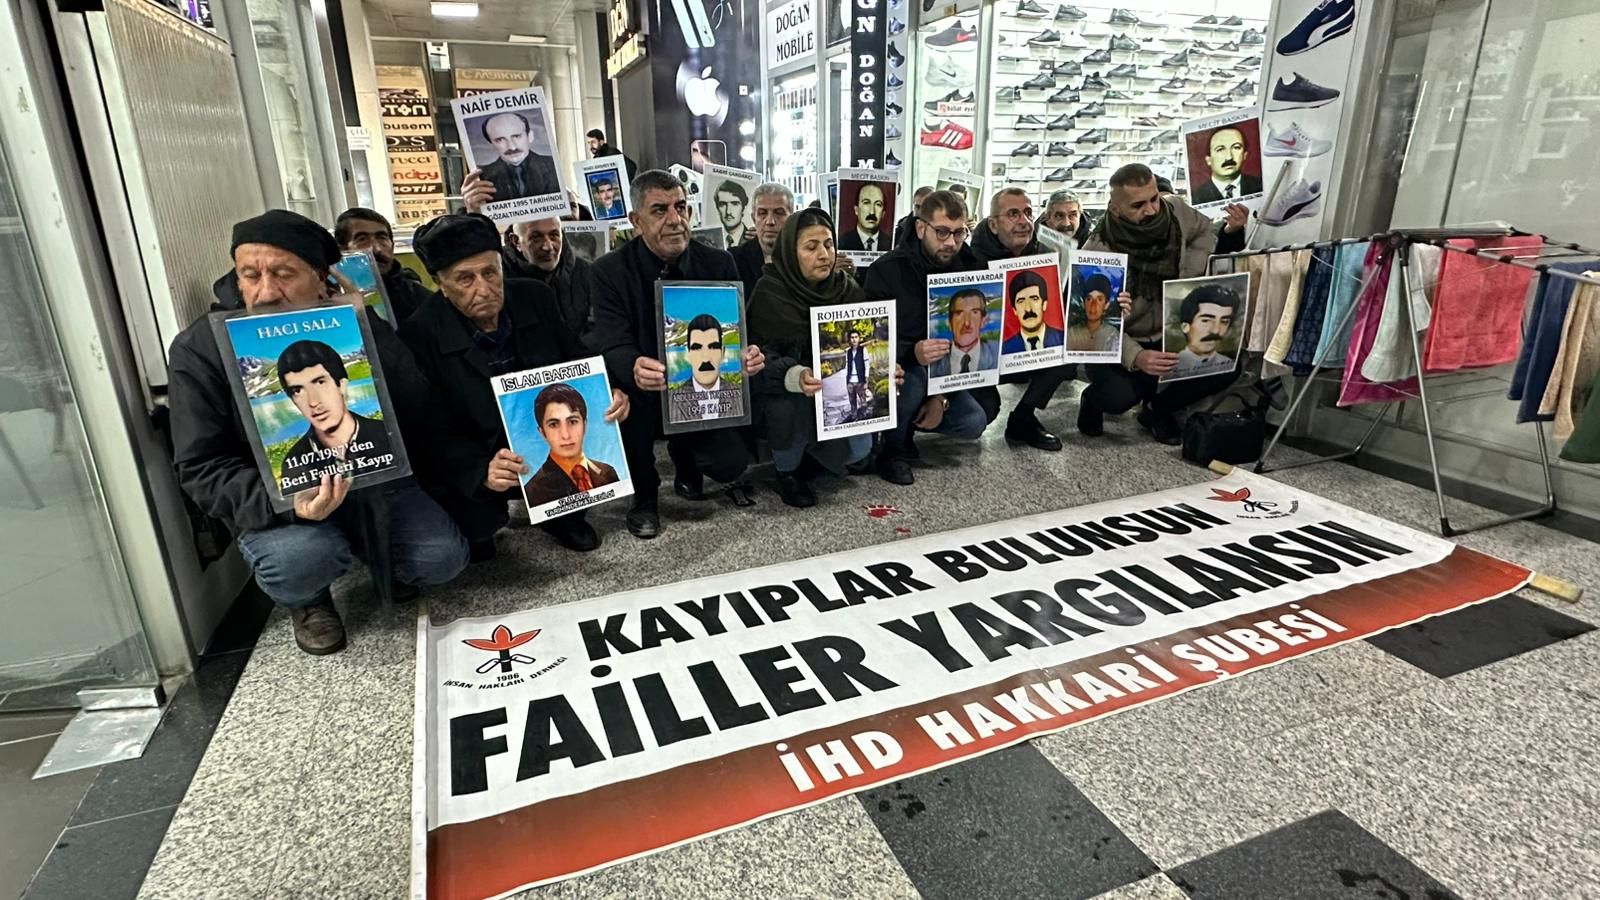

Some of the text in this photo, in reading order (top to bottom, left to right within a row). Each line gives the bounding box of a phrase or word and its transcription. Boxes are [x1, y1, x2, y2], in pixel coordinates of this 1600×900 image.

[776, 4, 810, 33] DOĞAN
[777, 30, 813, 62] MOBİLE
[460, 98, 492, 115] NAİF
[495, 91, 539, 109] DEMİR
[859, 54, 875, 137] DOĞAN
[489, 210, 530, 221] GÖZALTINDA
[492, 202, 512, 211] MART
[928, 273, 1004, 286] ABDULKERİM VARDAR
[257, 317, 341, 339] HACI SALA
[817, 306, 889, 321] ROJHAT ÖZDEL
[500, 362, 590, 392] İSLAM BARTIN
[286, 440, 374, 469] 11.07.1987'den
[281, 453, 393, 489] Beri Failleri Kayıp
[578, 503, 1231, 662] KAYIPLAR BULUNSUN
[450, 520, 1414, 797] FAİLLER YARGILANSIN
[478, 678, 524, 690] HAKLARI
[497, 673, 520, 682] 1986
[776, 604, 1348, 792] İHD HAKKARİ ŞUBESİ
